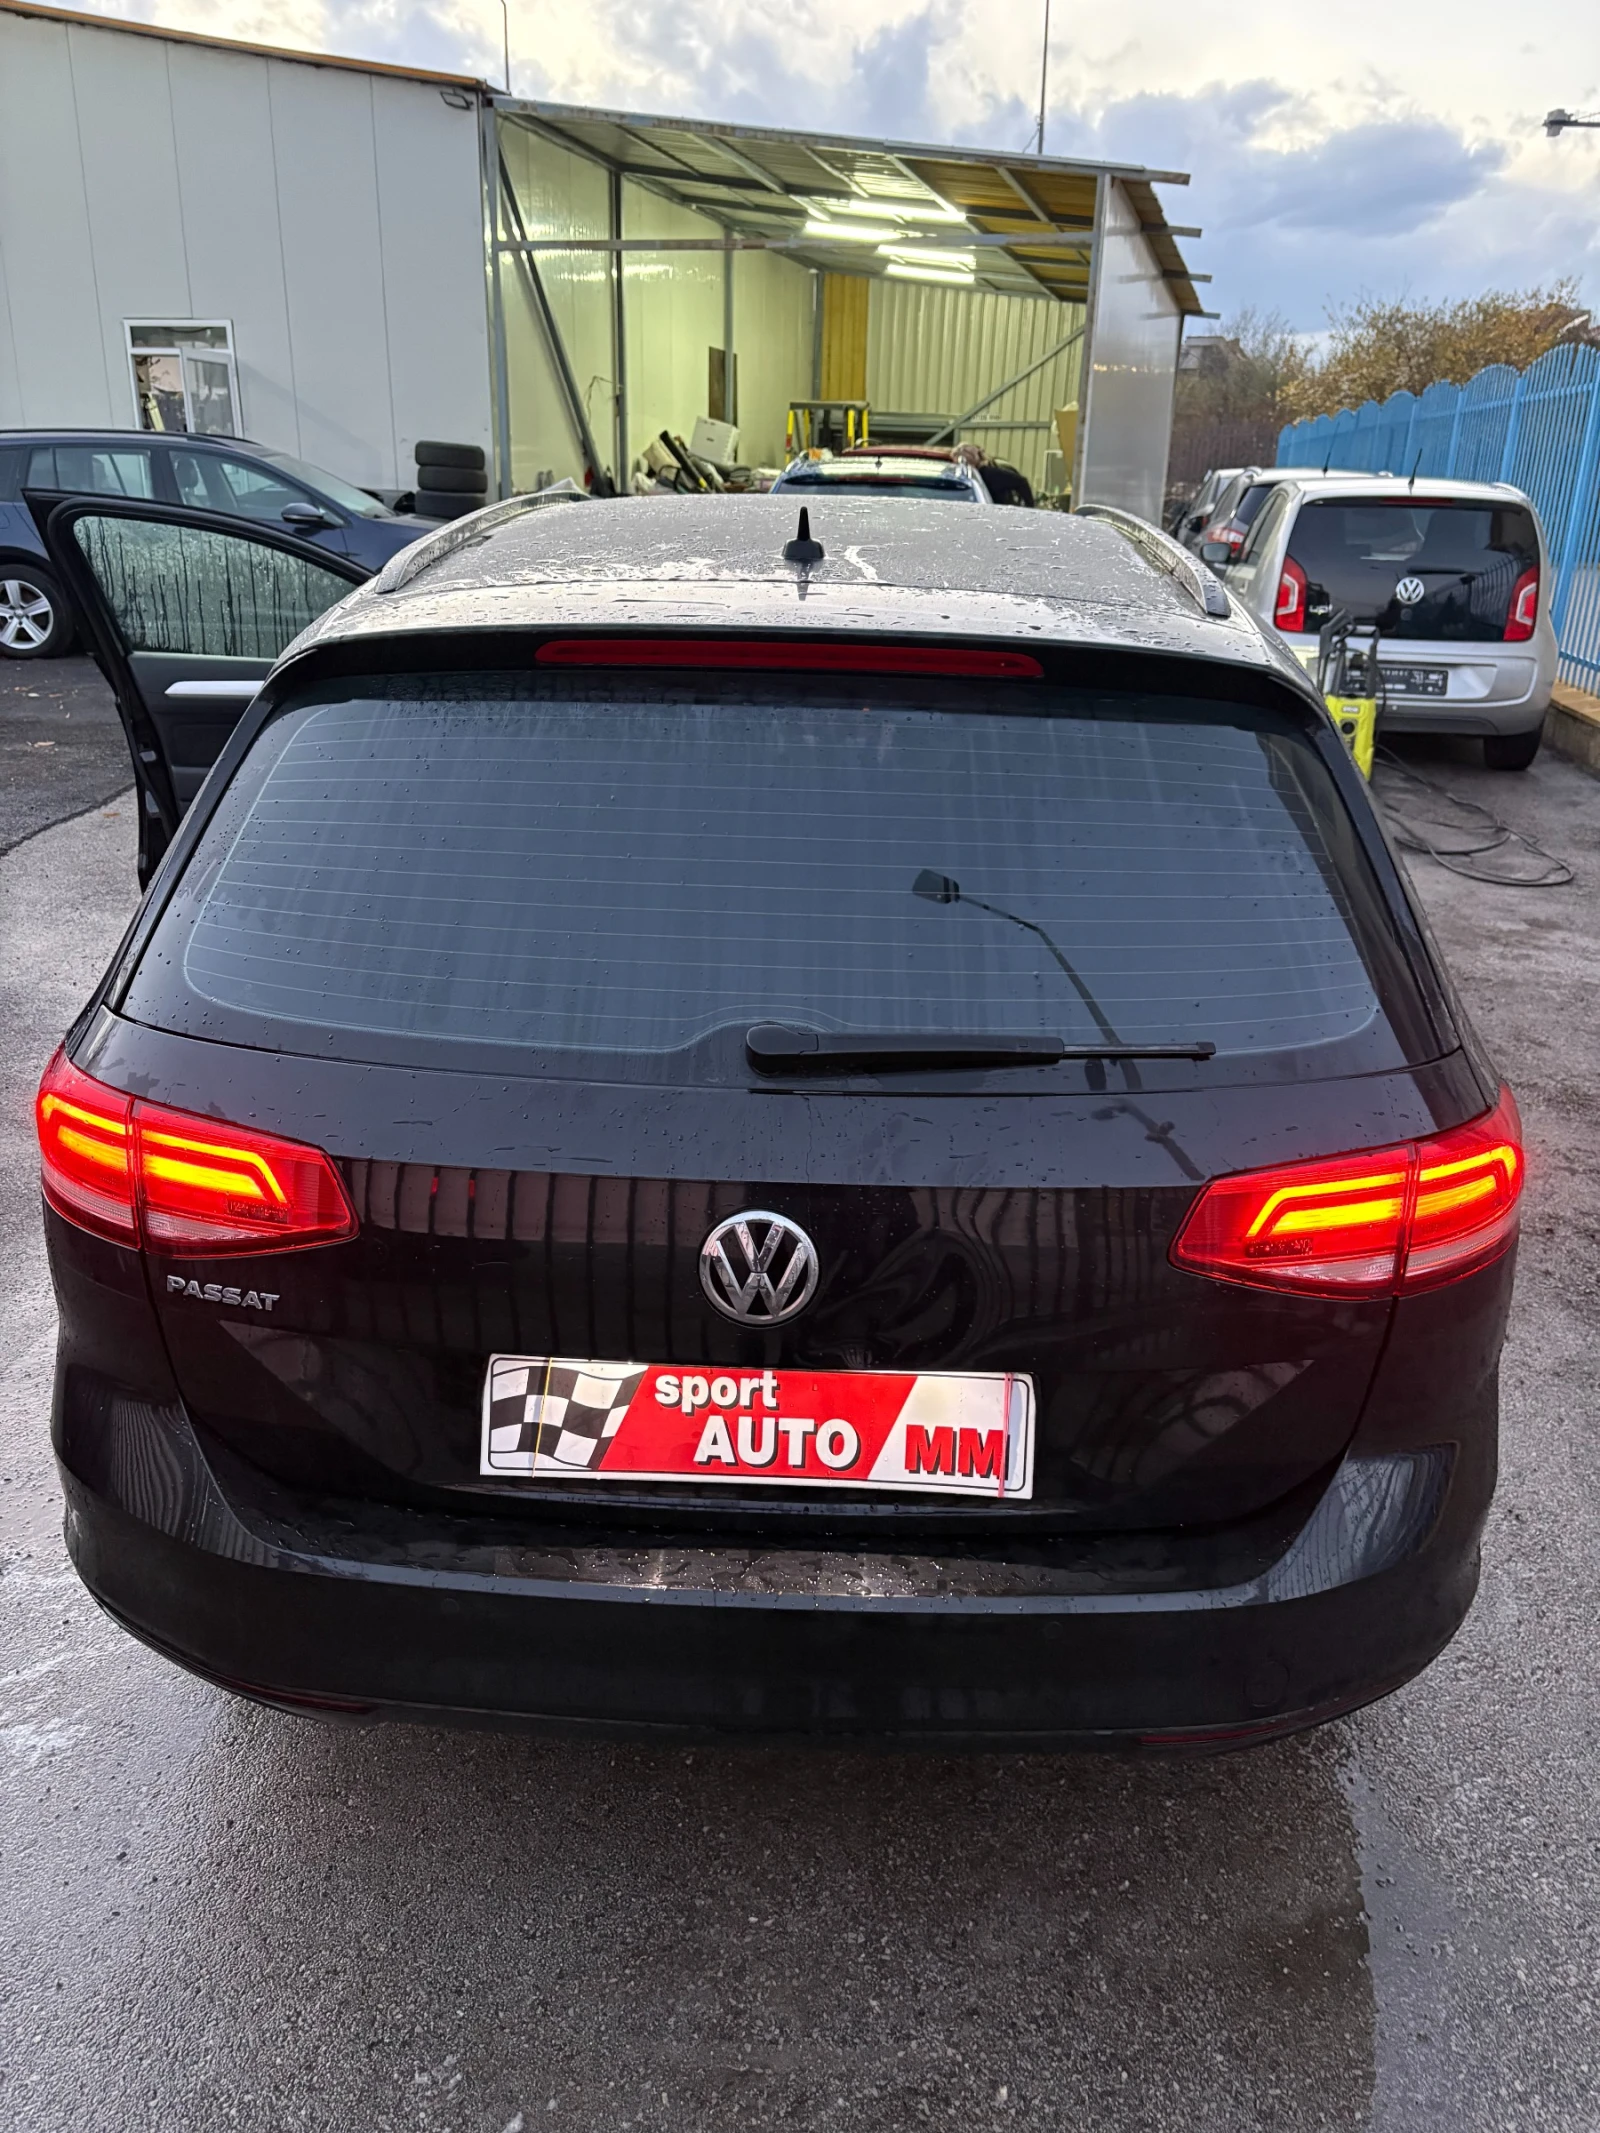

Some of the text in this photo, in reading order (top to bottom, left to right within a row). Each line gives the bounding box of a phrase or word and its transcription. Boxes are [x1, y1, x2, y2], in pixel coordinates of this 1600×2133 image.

[1396, 577, 1424, 604] VW
[702, 1210, 819, 1324] VW
[167, 1275, 280, 1311] PASSAT
[655, 1371, 778, 1413] sport
[693, 1415, 1008, 1479] AUTO MM
